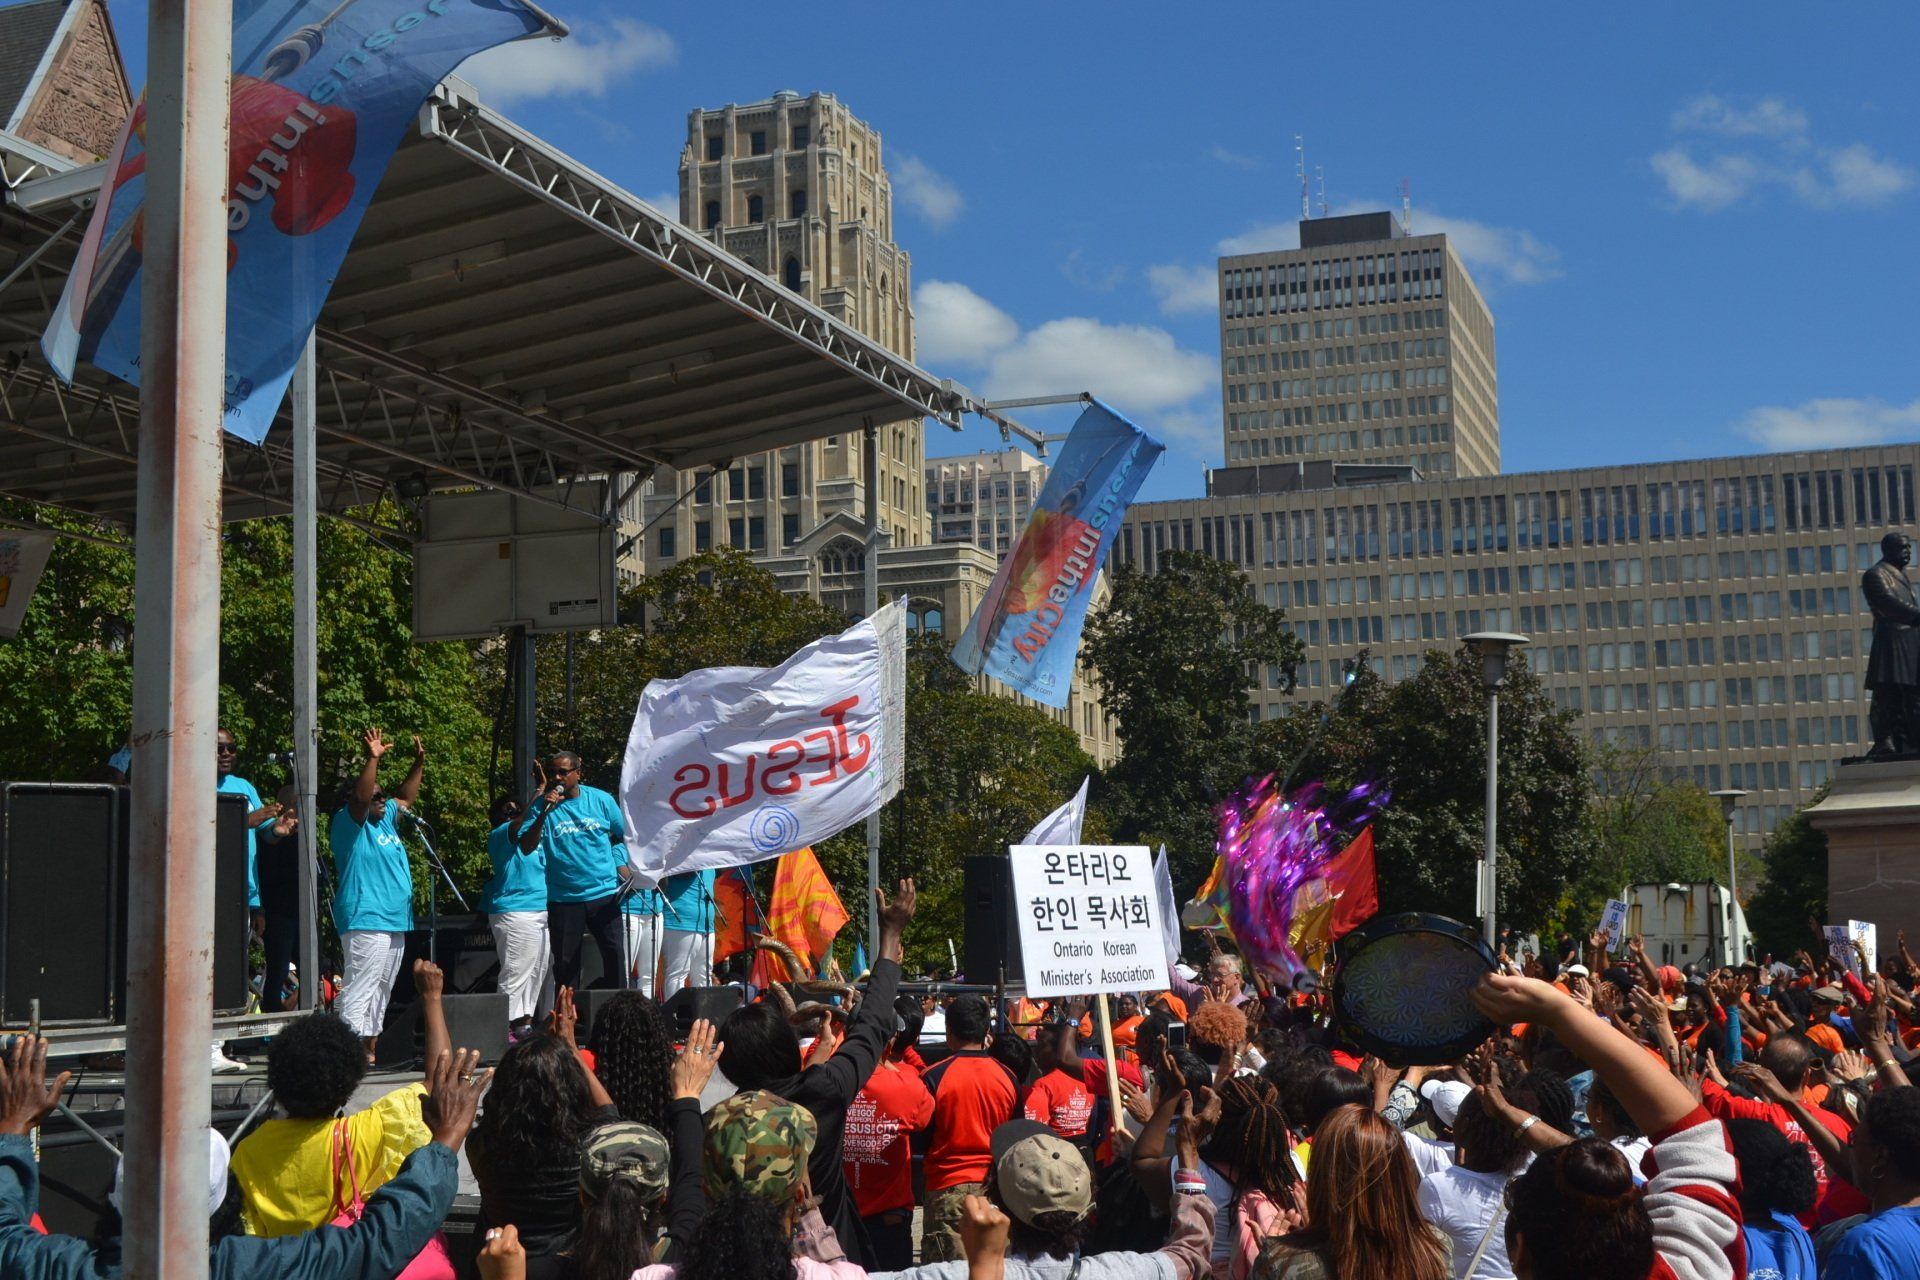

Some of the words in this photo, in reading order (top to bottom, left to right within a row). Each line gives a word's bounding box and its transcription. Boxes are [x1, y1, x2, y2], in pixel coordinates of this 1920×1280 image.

[1044, 852, 1132, 886] 온타리오
[1031, 897, 1079, 931] 한인
[1086, 895, 1151, 930] 목사회
[1053, 940, 1093, 958] Ontario
[1103, 941, 1137, 956] Korean
[1040, 969, 1093, 987] Minister's
[1101, 966, 1155, 985] Association
[844, 1124, 870, 1134] ESUS
[876, 1124, 900, 1133] CITY
